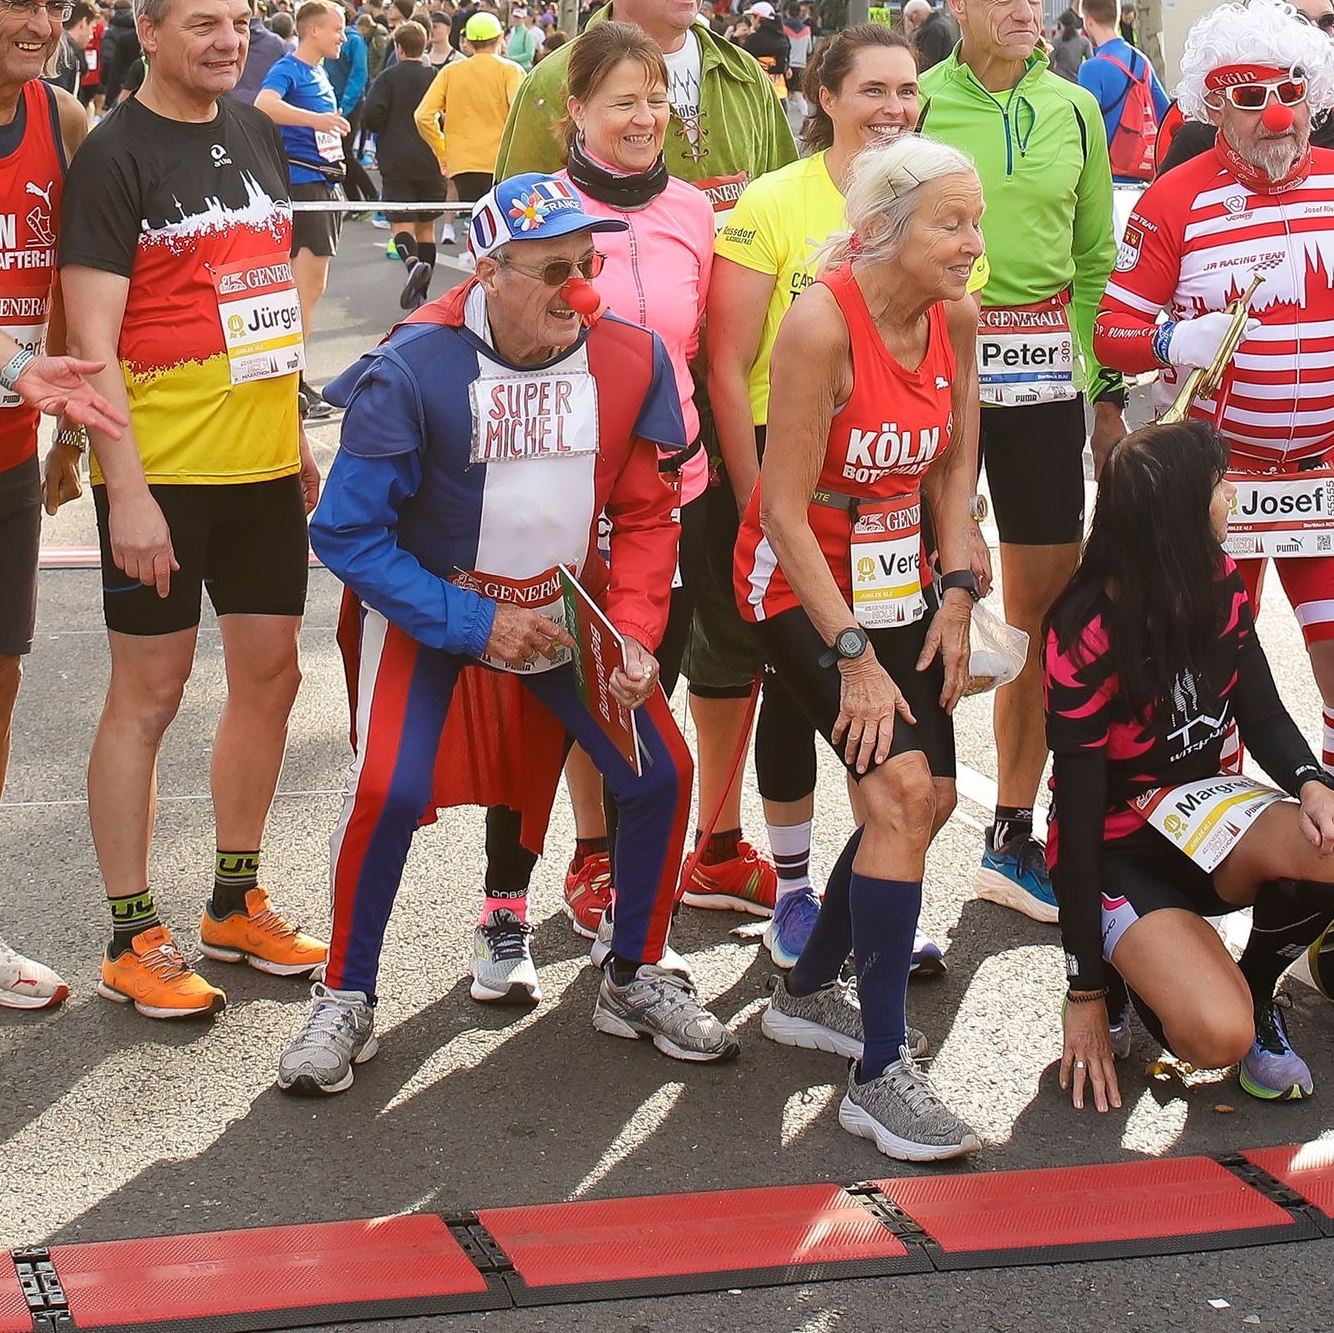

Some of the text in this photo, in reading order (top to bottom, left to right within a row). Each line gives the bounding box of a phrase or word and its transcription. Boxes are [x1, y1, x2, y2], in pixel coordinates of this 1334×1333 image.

[1214, 70, 1258, 86] Köln
[544, 200, 582, 214] FRANCE
[1303, 206, 1323, 214] Josef
[1203, 251, 1285, 271] JR RACING TEAM
[987, 310, 1064, 327] GENERALI
[981, 342, 1058, 367] Peter
[1061, 340, 1071, 363] 309
[488, 380, 572, 420] SUPER
[1015, 394, 1038, 403] PUMA
[845, 422, 940, 468] KÖLN
[1241, 486, 1324, 516] Josef
[1276, 544, 1300, 553] PUMA
